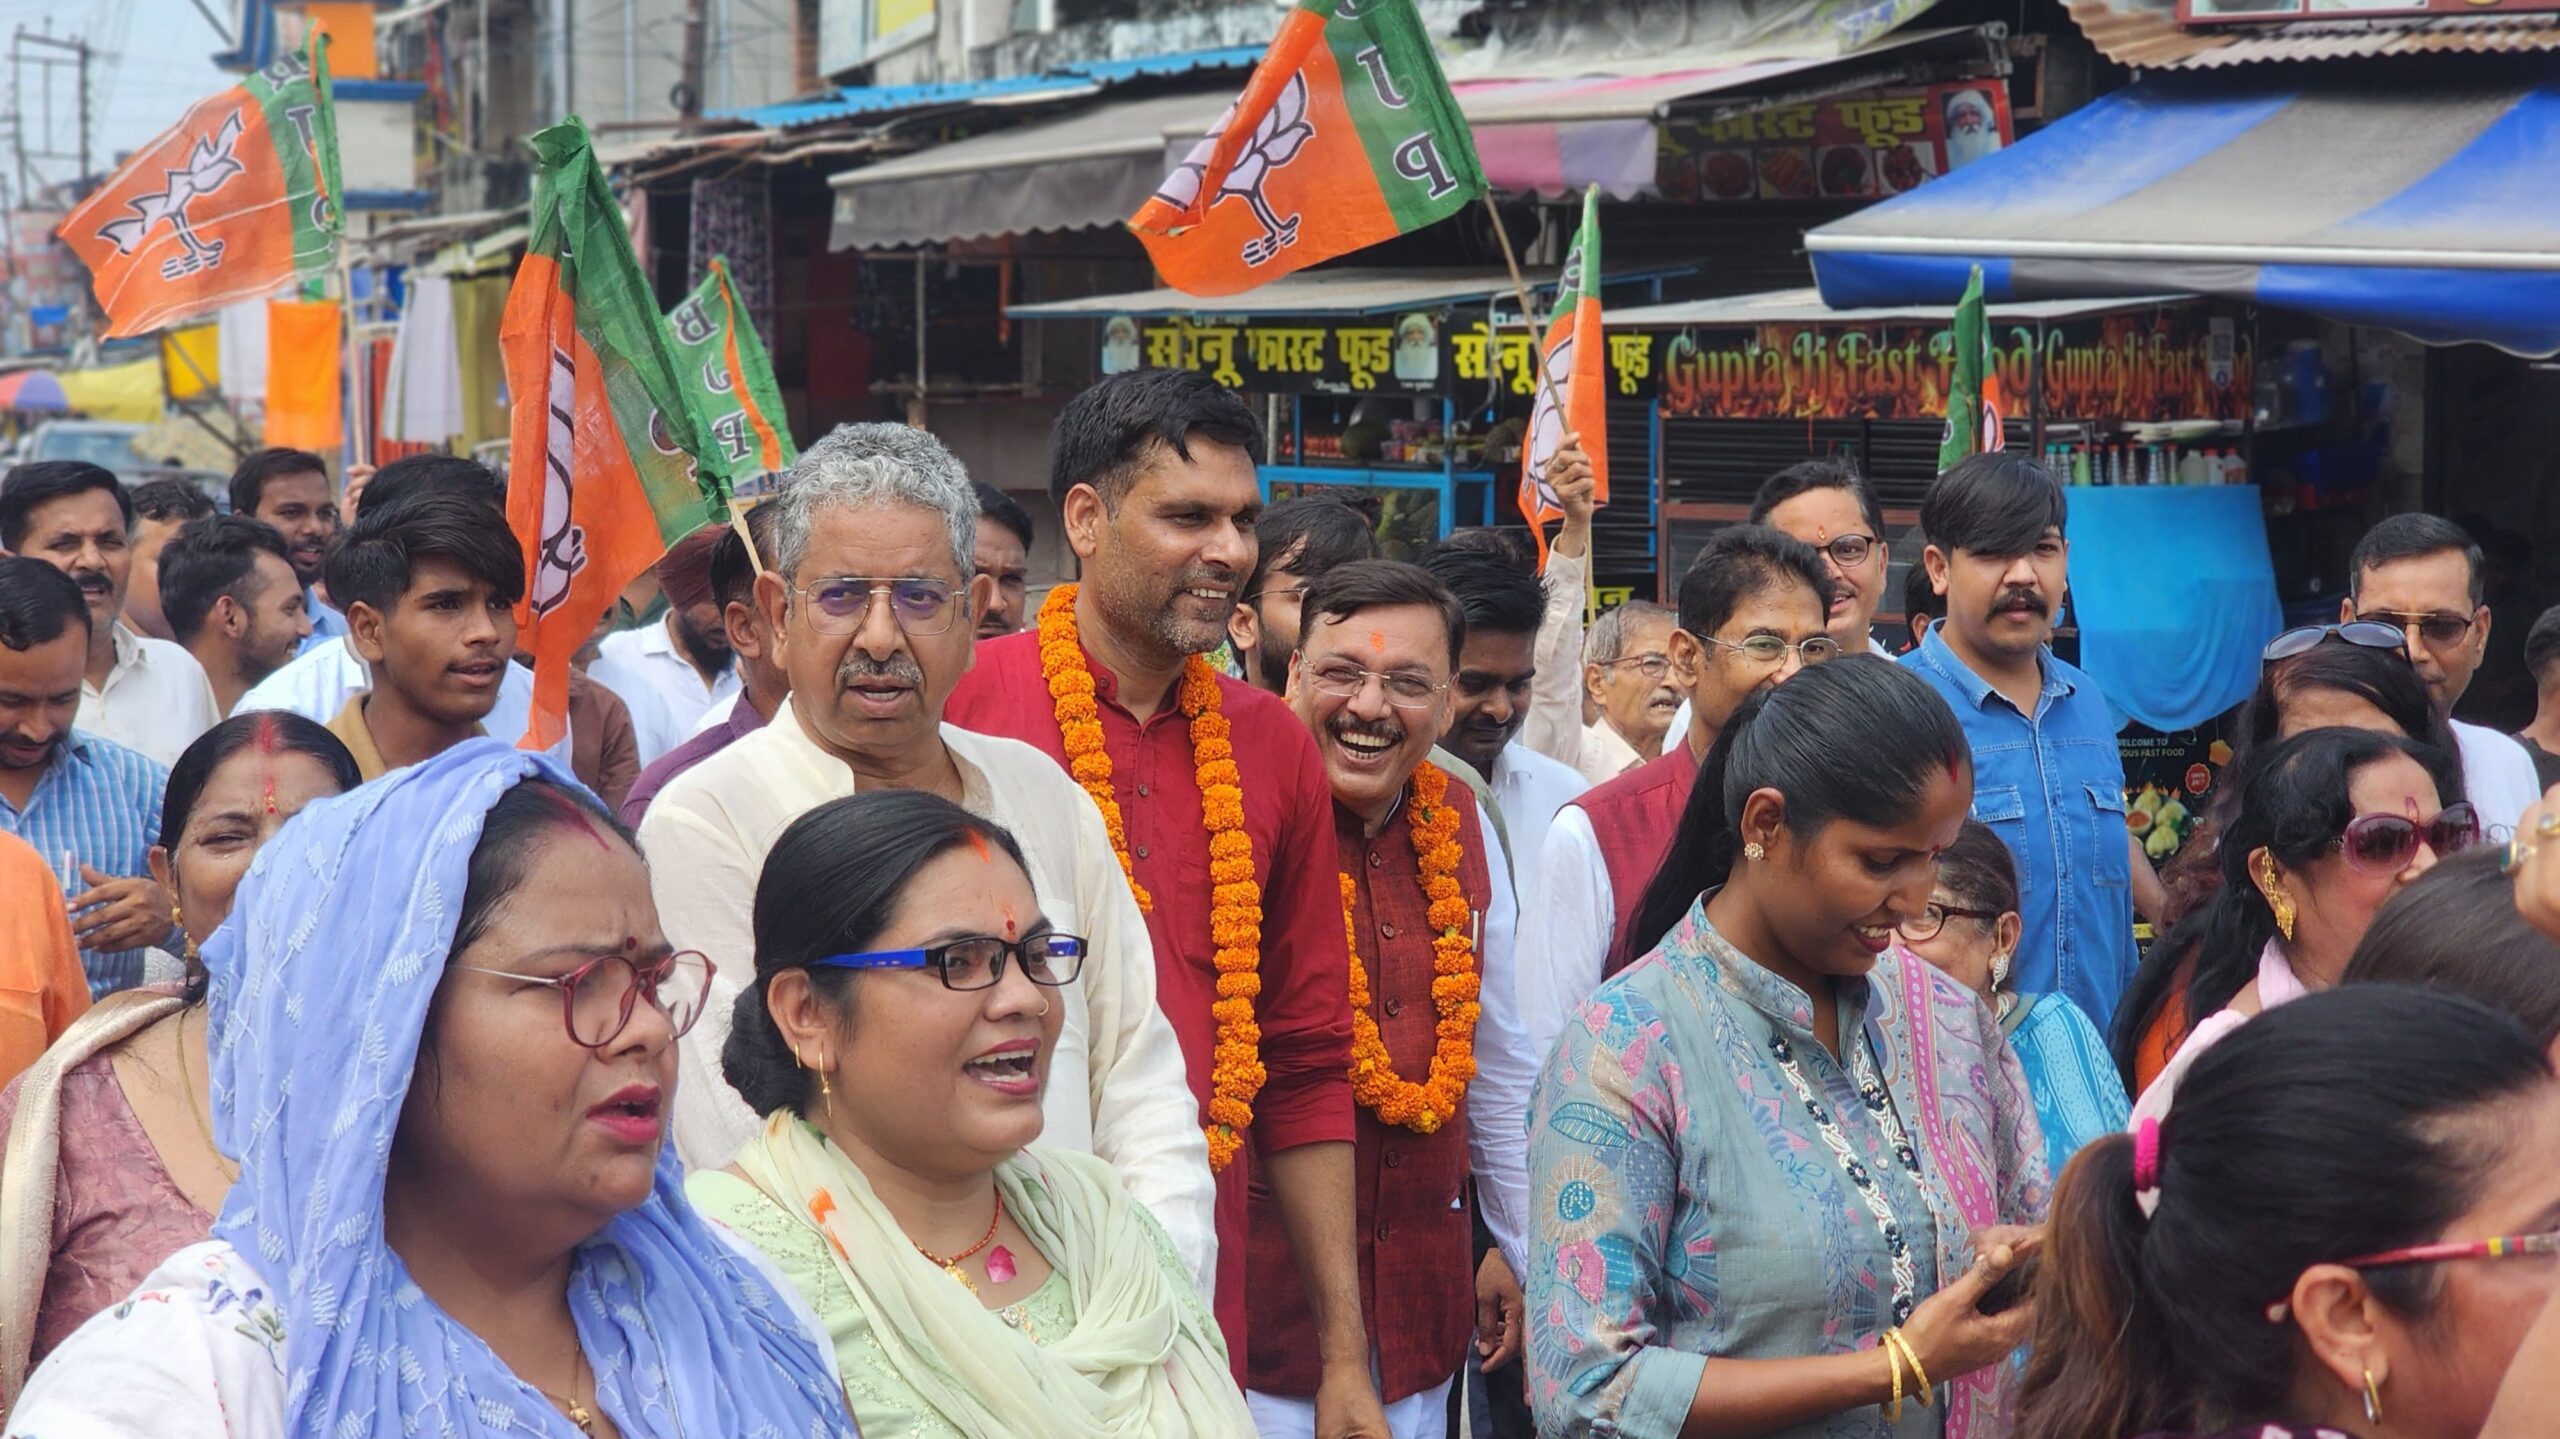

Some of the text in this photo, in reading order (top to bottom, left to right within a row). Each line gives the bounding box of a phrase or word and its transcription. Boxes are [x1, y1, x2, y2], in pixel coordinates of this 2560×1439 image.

[1833, 97, 1927, 148] फूड
[1336, 328, 1391, 390] फूड
[1665, 333, 1783, 406] Gupta
[1792, 330, 1827, 408] Ji
[1837, 331, 1920, 398] Fast
[2046, 328, 2117, 407] Gupta
[2149, 332, 2194, 396] Fast
[2141, 748, 2160, 758] FAST
[2161, 747, 2185, 757] FOOD
[2156, 738, 2169, 747] TO
